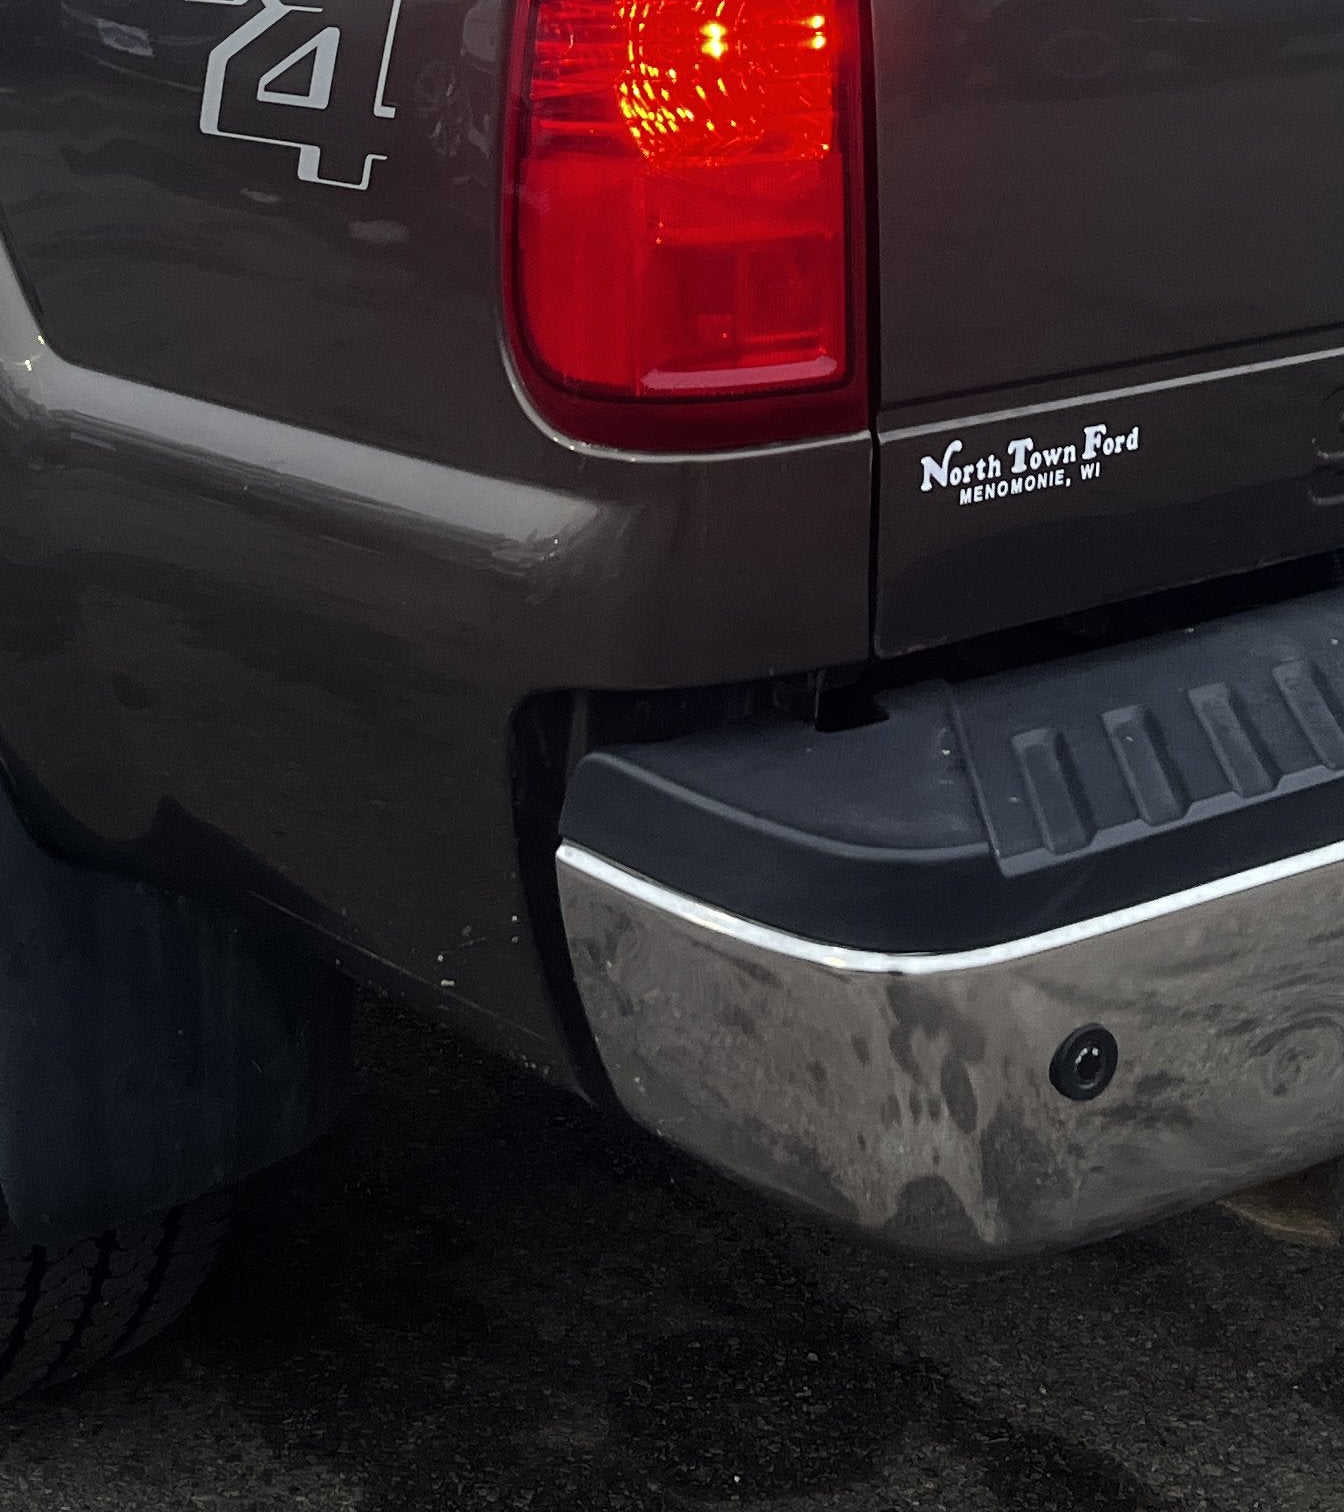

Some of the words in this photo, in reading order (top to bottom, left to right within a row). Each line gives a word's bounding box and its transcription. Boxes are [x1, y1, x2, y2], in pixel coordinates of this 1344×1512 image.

[919, 439, 1002, 492] North
[1007, 437, 1077, 474] Town
[1081, 423, 1140, 461] Ford
[959, 467, 1073, 506] MENOMONIE,
[1080, 462, 1101, 481] WI
